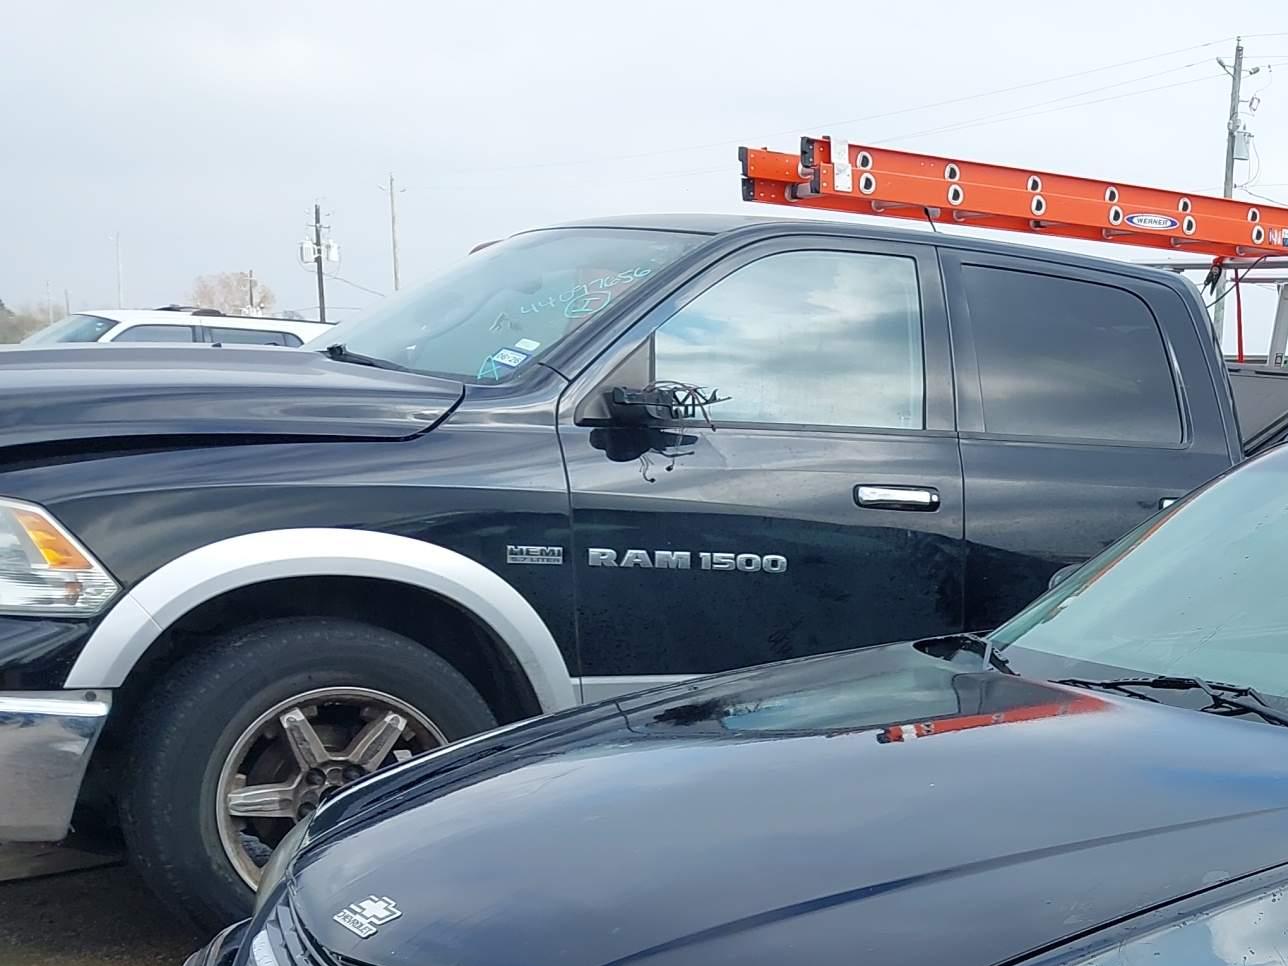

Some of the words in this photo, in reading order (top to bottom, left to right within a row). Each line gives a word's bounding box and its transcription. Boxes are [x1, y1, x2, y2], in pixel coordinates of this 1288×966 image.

[1137, 216, 1168, 225] WERNER
[477, 355, 499, 380] A
[508, 545, 562, 557] HEMI
[588, 548, 691, 569] RAM
[700, 552, 788, 573] 1500
[336, 911, 373, 935] CHEVROLET
